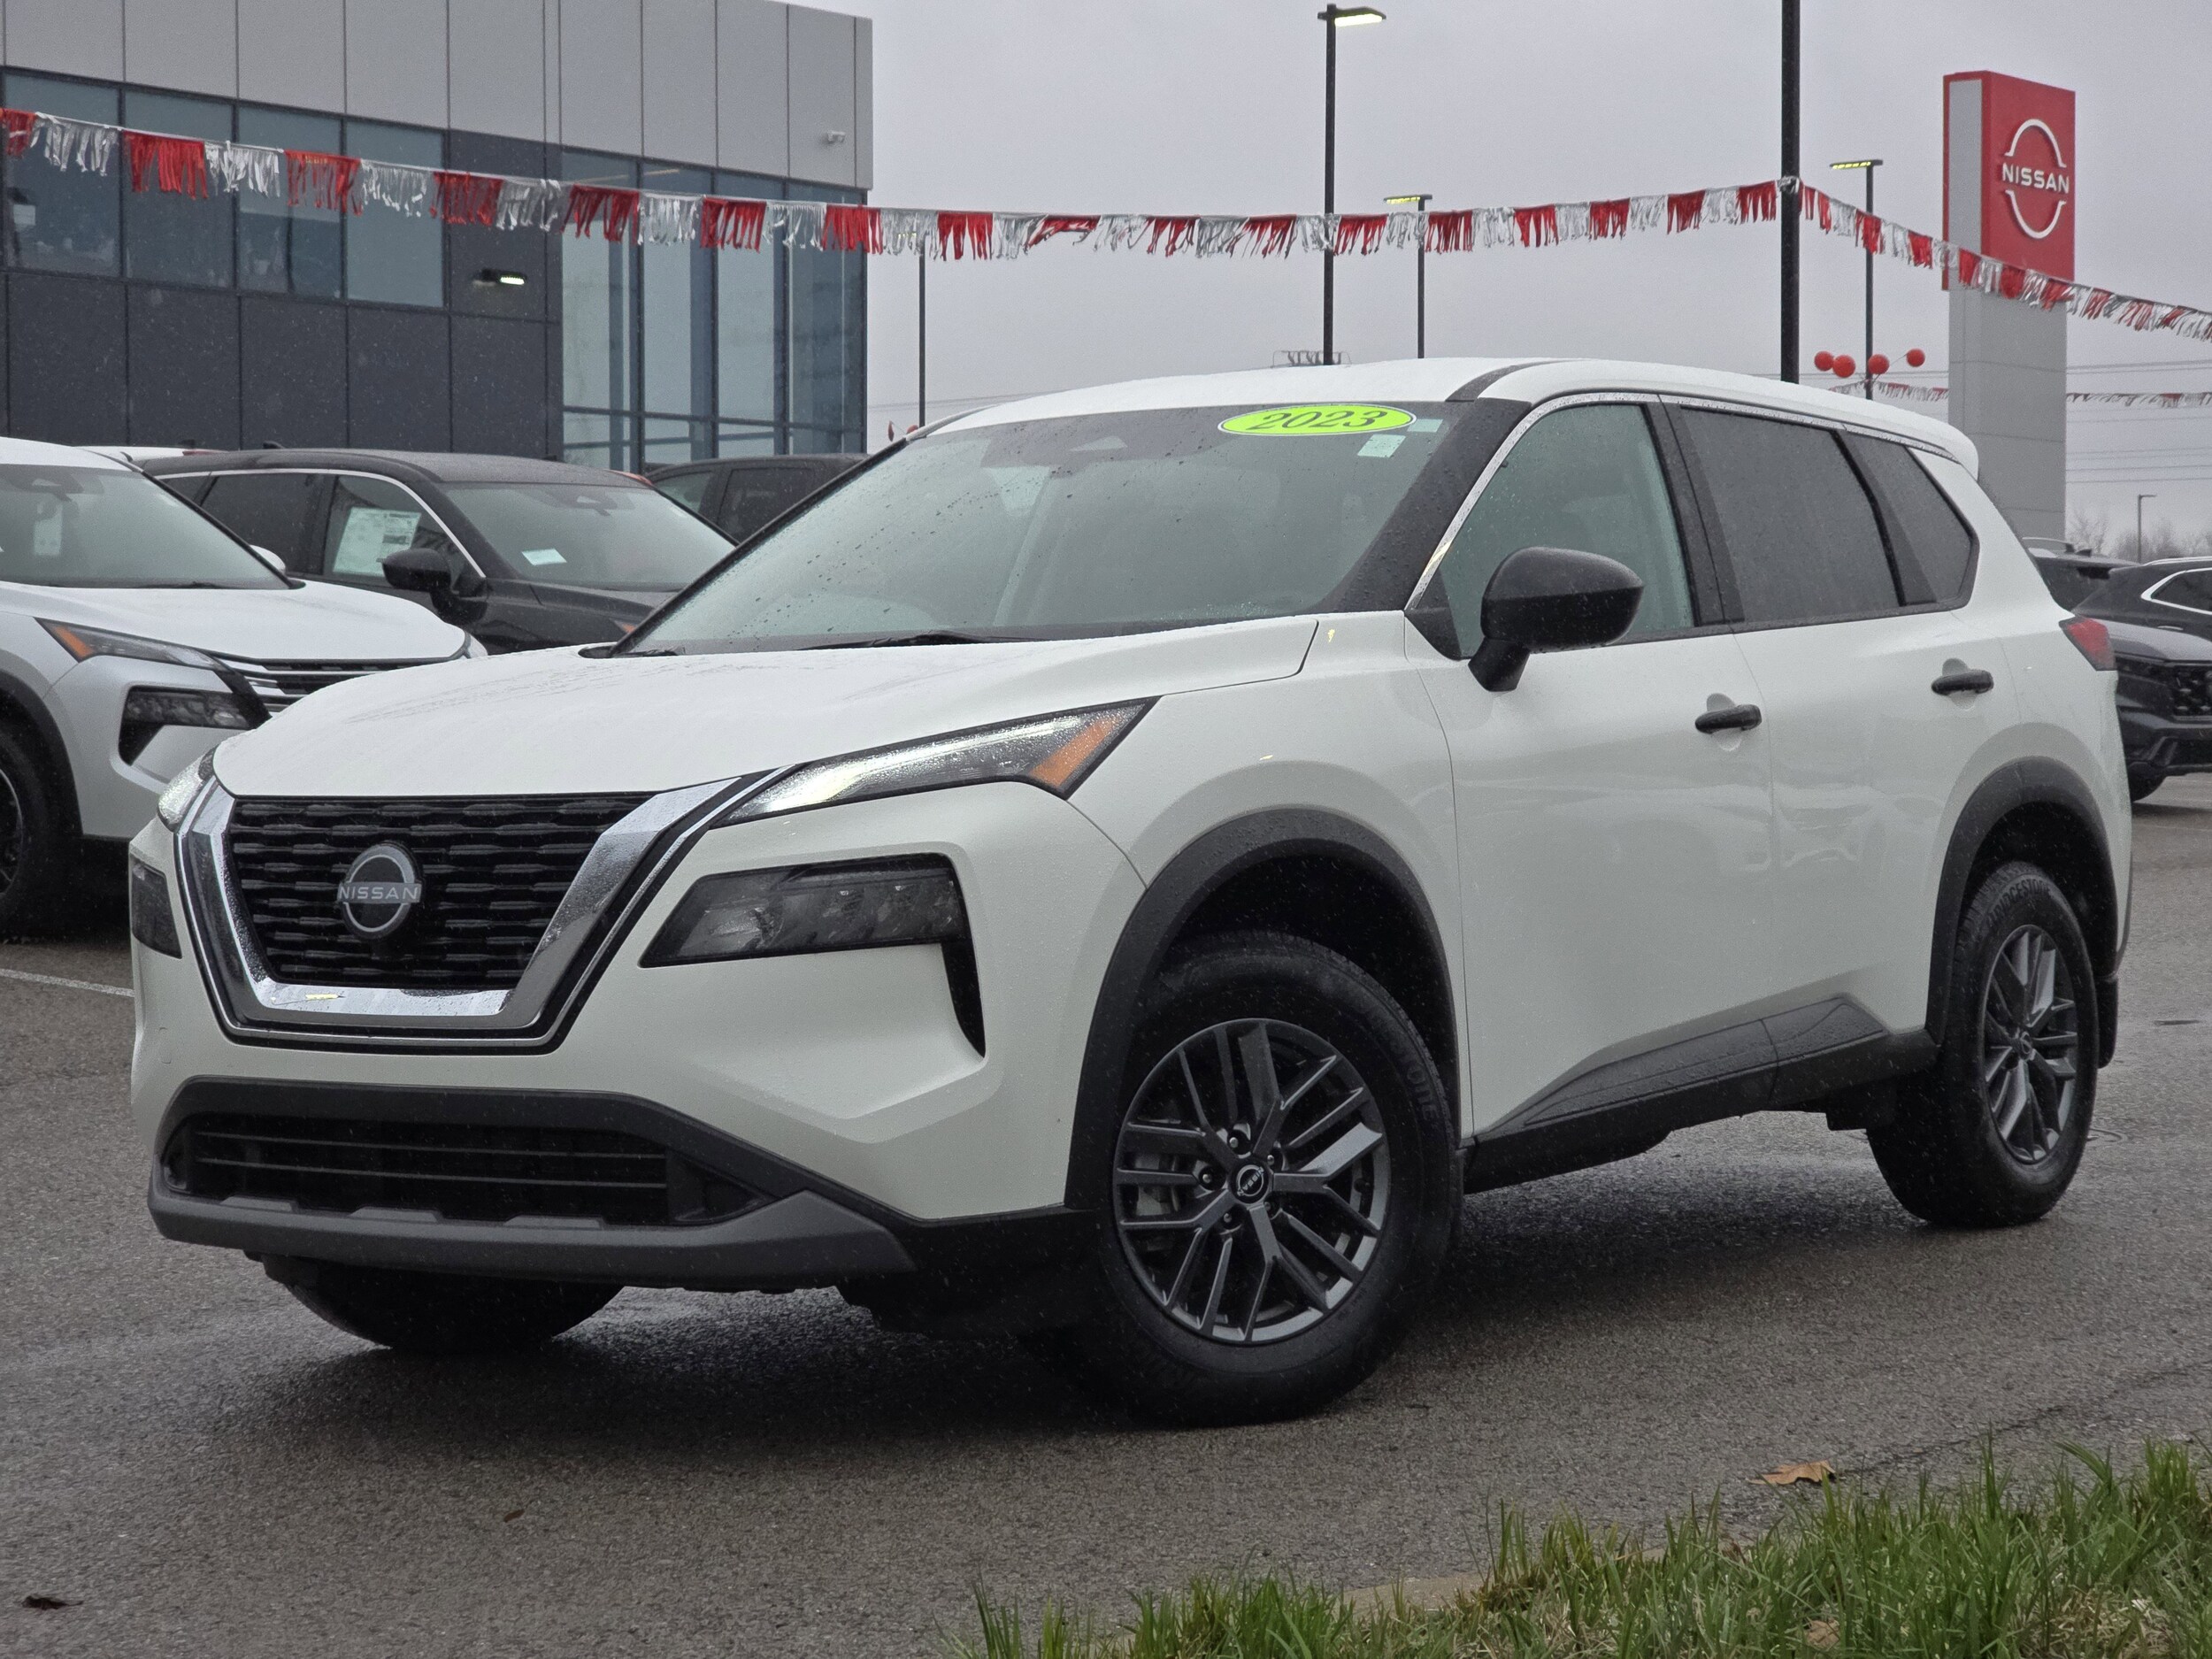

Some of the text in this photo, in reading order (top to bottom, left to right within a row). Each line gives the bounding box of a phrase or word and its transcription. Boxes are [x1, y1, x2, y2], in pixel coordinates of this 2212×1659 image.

[2002, 162, 2070, 194] NISSAN
[1245, 410, 1388, 431] 2023
[338, 885, 419, 901] NISSAN
